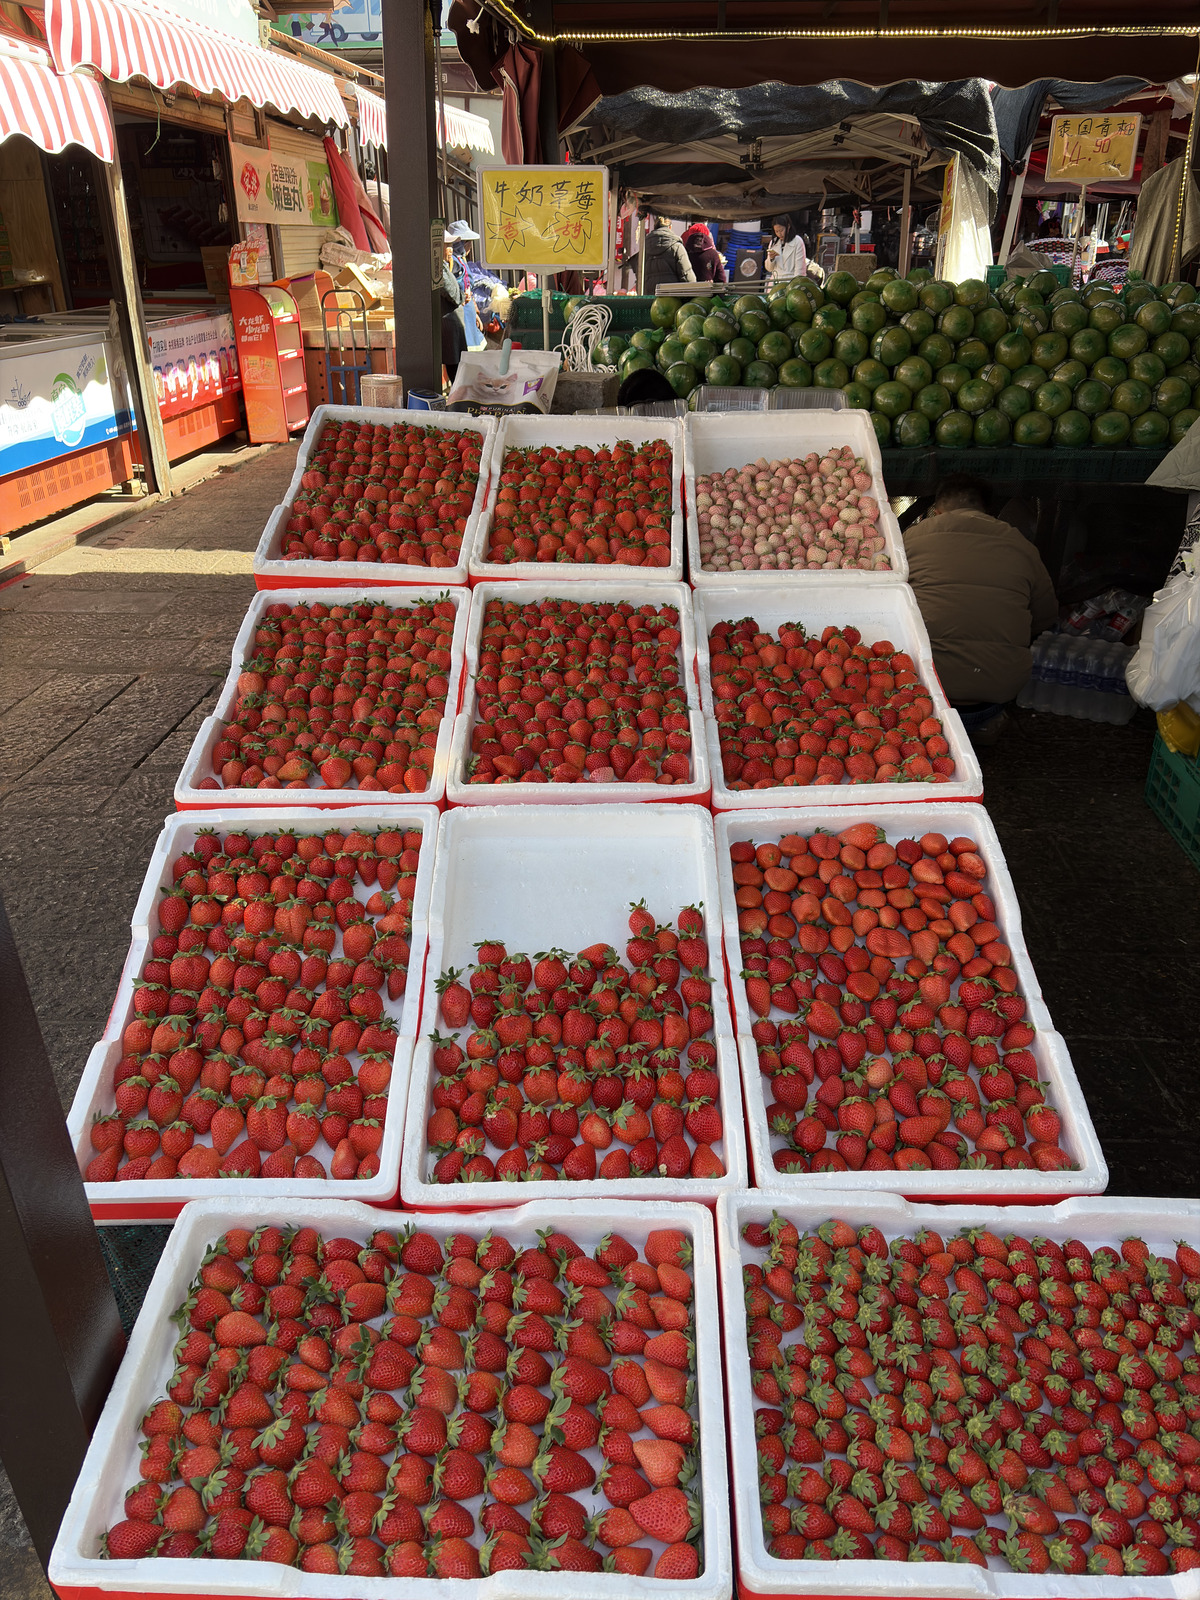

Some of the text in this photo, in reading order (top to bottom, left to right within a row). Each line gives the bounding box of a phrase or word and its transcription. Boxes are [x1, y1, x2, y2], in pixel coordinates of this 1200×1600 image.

[272, 182, 303, 213] 嫩鱼丸
[494, 180, 596, 210] 牛奶草莓
[499, 217, 583, 240] 香 甜
[238, 314, 264, 326] 大龙虾
